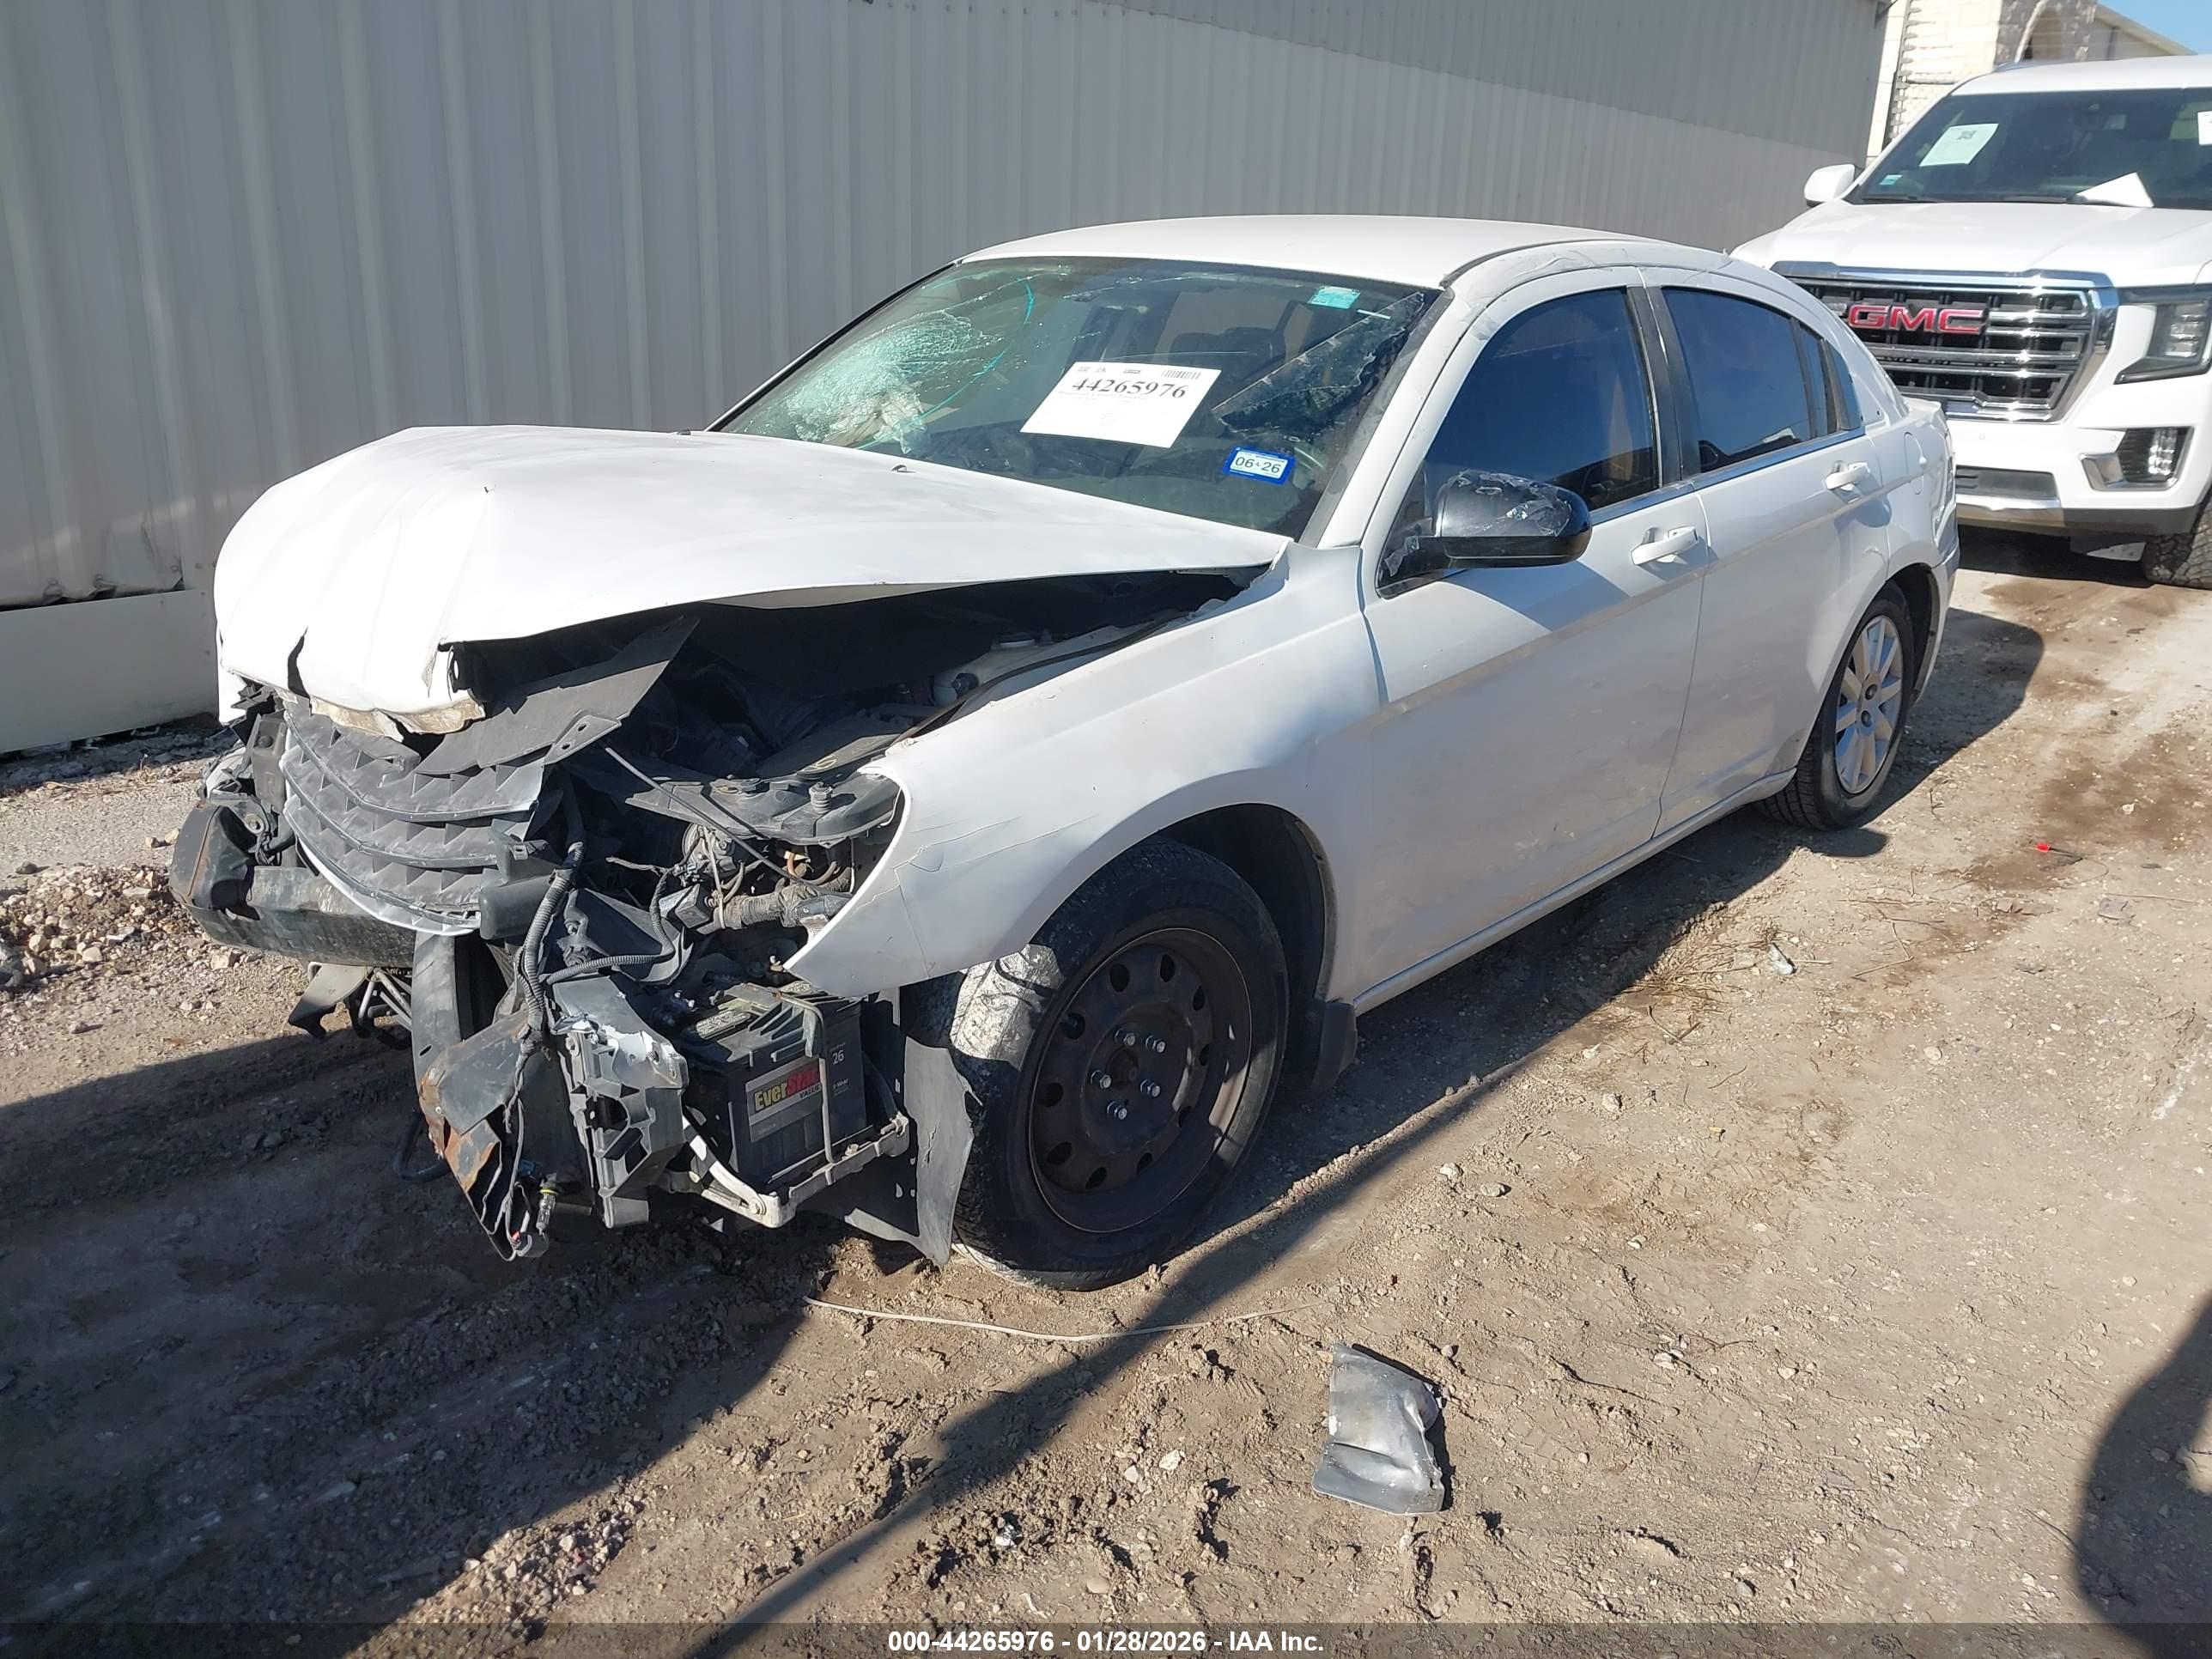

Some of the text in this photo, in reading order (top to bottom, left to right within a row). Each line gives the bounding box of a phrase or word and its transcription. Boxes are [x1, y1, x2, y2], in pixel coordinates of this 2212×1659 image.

[1848, 304, 1986, 335] GMC
[1072, 378, 1189, 398] 44265976
[1235, 456, 1282, 473] 06 26
[832, 1049, 845, 1065] 26
